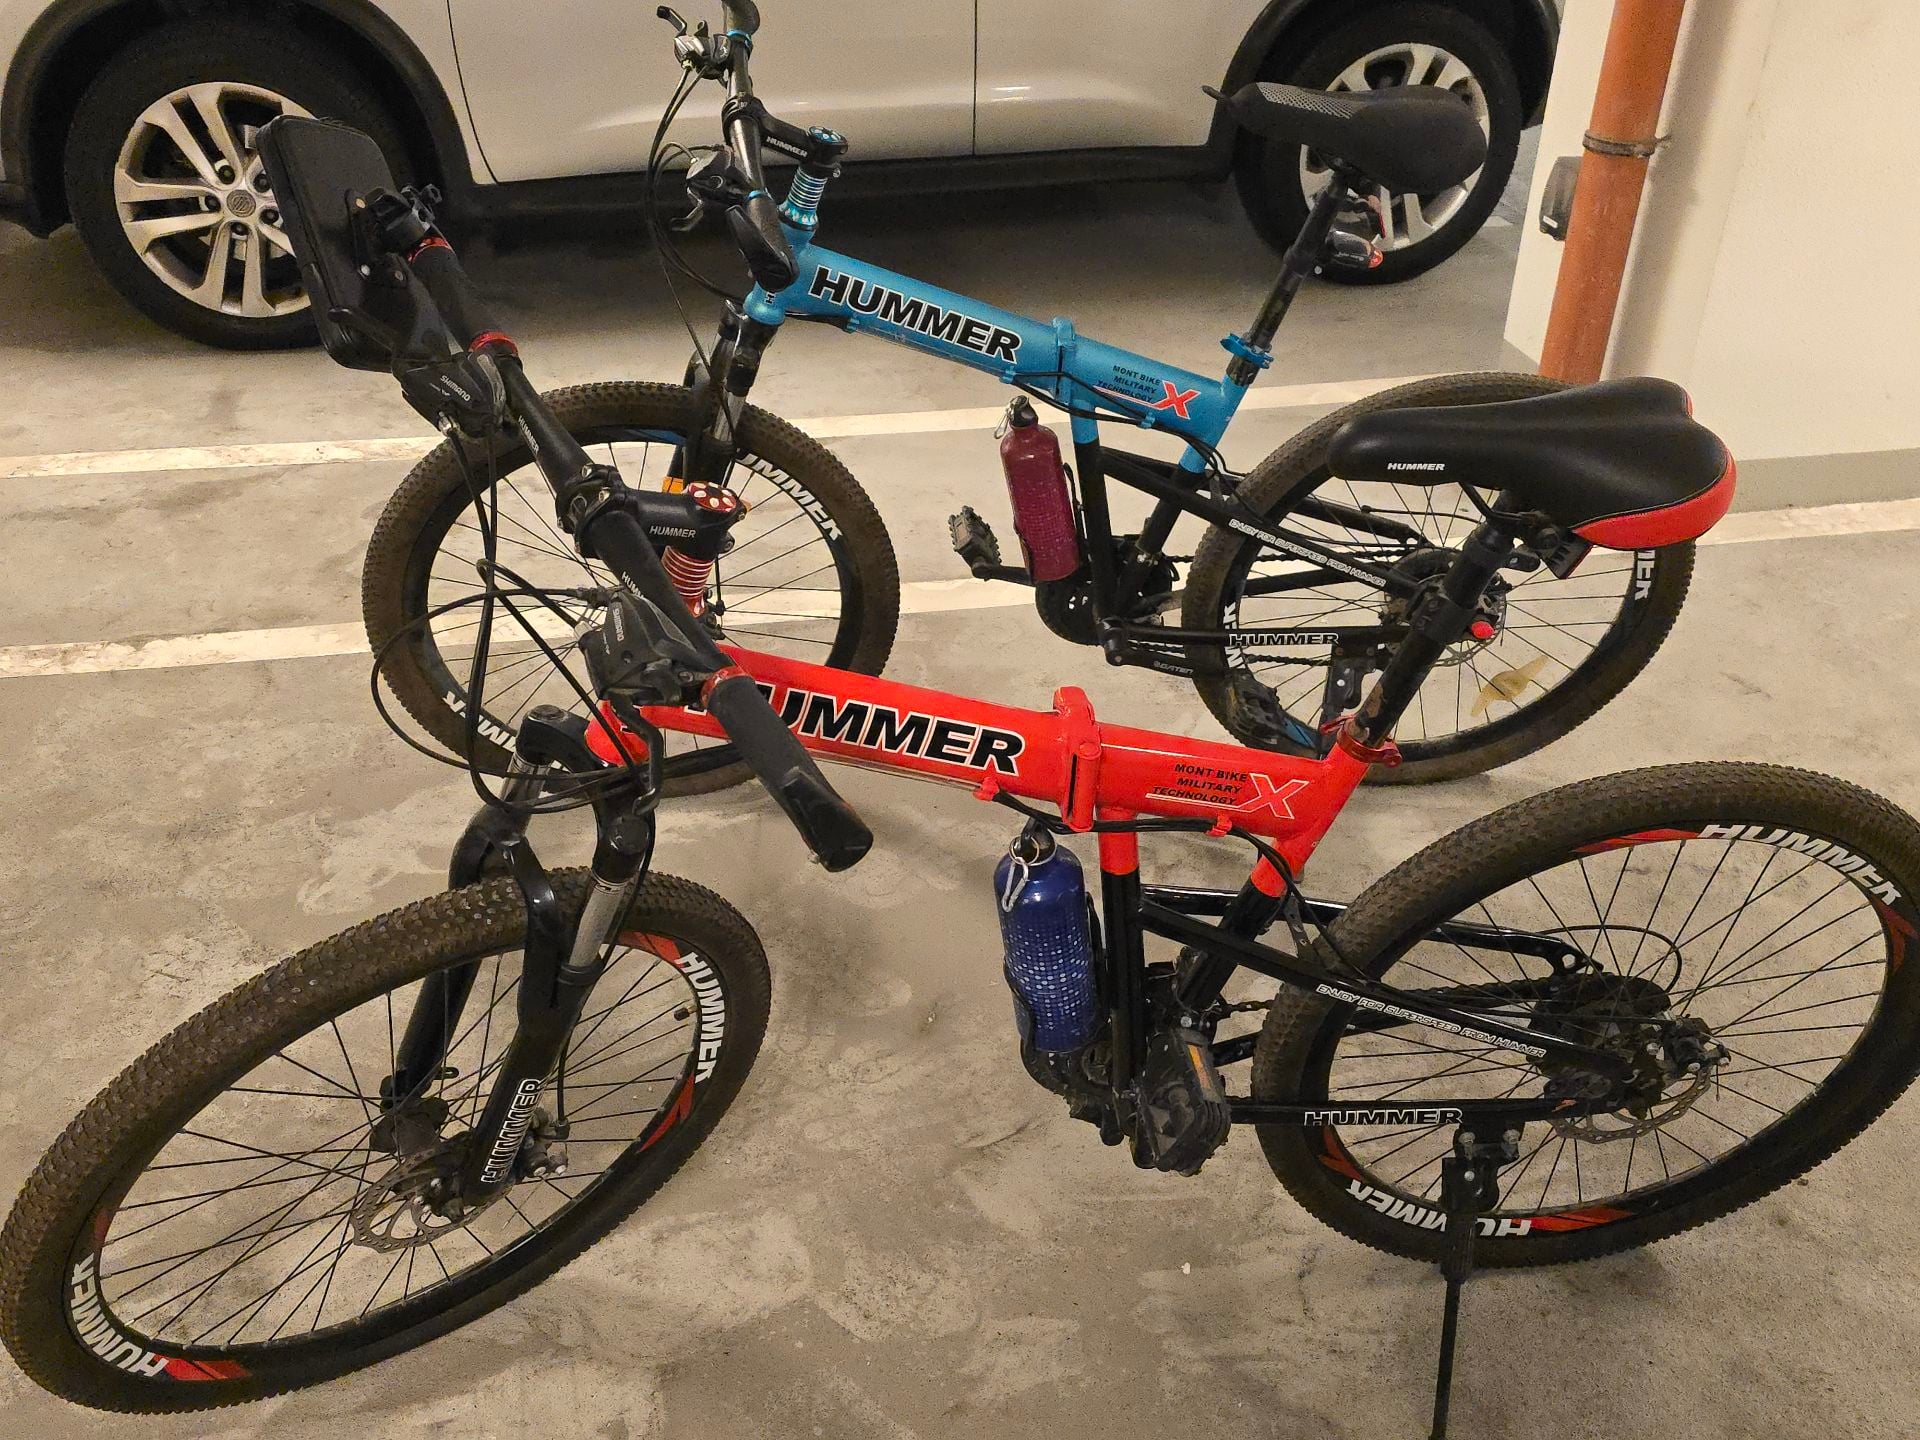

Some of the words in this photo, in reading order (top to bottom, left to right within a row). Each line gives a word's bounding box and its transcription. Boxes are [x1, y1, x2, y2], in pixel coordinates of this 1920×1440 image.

[808, 265, 1022, 364] HUMMER
[440, 375, 471, 402] SHIMANO
[1113, 365, 1139, 379] MONT
[1140, 374, 1161, 385] BIKE
[1113, 375, 1157, 394] MILITARY
[1097, 380, 1153, 403] TECHNOLOGY
[1153, 380, 1201, 420] X
[1387, 463, 1446, 471] HUMMER
[736, 453, 843, 541] UMMER
[649, 525, 696, 539] HUMMER
[1229, 633, 1339, 645] HUMMER
[684, 681, 1025, 777] UMMER
[1175, 764, 1214, 779] MONT
[1216, 770, 1248, 783] BIKE
[1177, 777, 1243, 794] MILITARY
[1152, 786, 1238, 805] TECHNOLOGY
[1240, 772, 1310, 820] X
[1698, 824, 1902, 905] HUMMER
[674, 951, 725, 1084] HUMMER
[1316, 984, 1361, 1002] ENJOY
[1358, 997, 1385, 1011] FOR
[1384, 1005, 1461, 1033] SUPERSPEED
[1460, 1028, 1496, 1044] FROM
[1494, 1034, 1547, 1058] HUMMER
[481, 1078, 543, 1183] HUMMER
[1304, 1108, 1463, 1126] HUMMER
[70, 1252, 170, 1377] HUMMER
